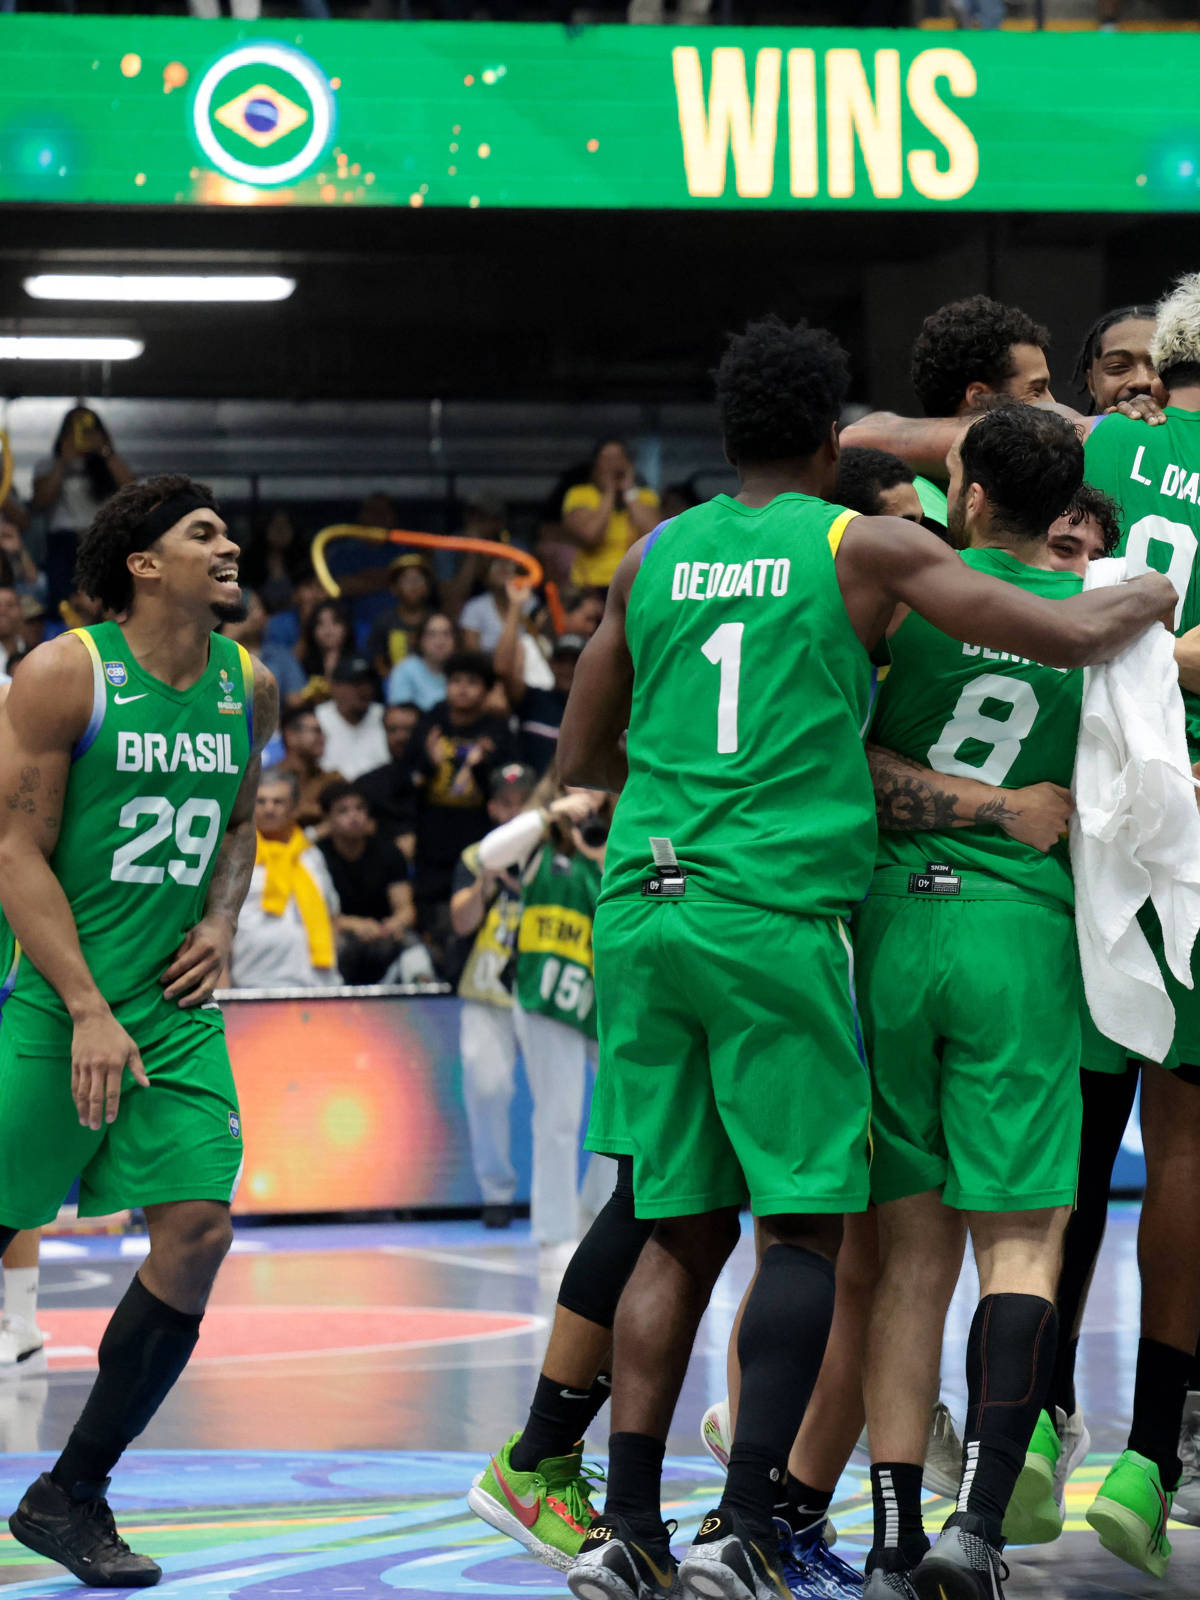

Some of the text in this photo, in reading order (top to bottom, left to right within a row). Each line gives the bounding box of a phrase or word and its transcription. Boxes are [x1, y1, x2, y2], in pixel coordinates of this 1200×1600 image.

[672, 46, 979, 200] WINS
[671, 558, 791, 600] DEODATO
[701, 622, 744, 754] 1
[116, 731, 239, 774] BRASIL
[926, 673, 1040, 787] 8
[110, 796, 221, 886] 29
[649, 880, 660, 890] 40
[918, 879, 930, 888] 40
